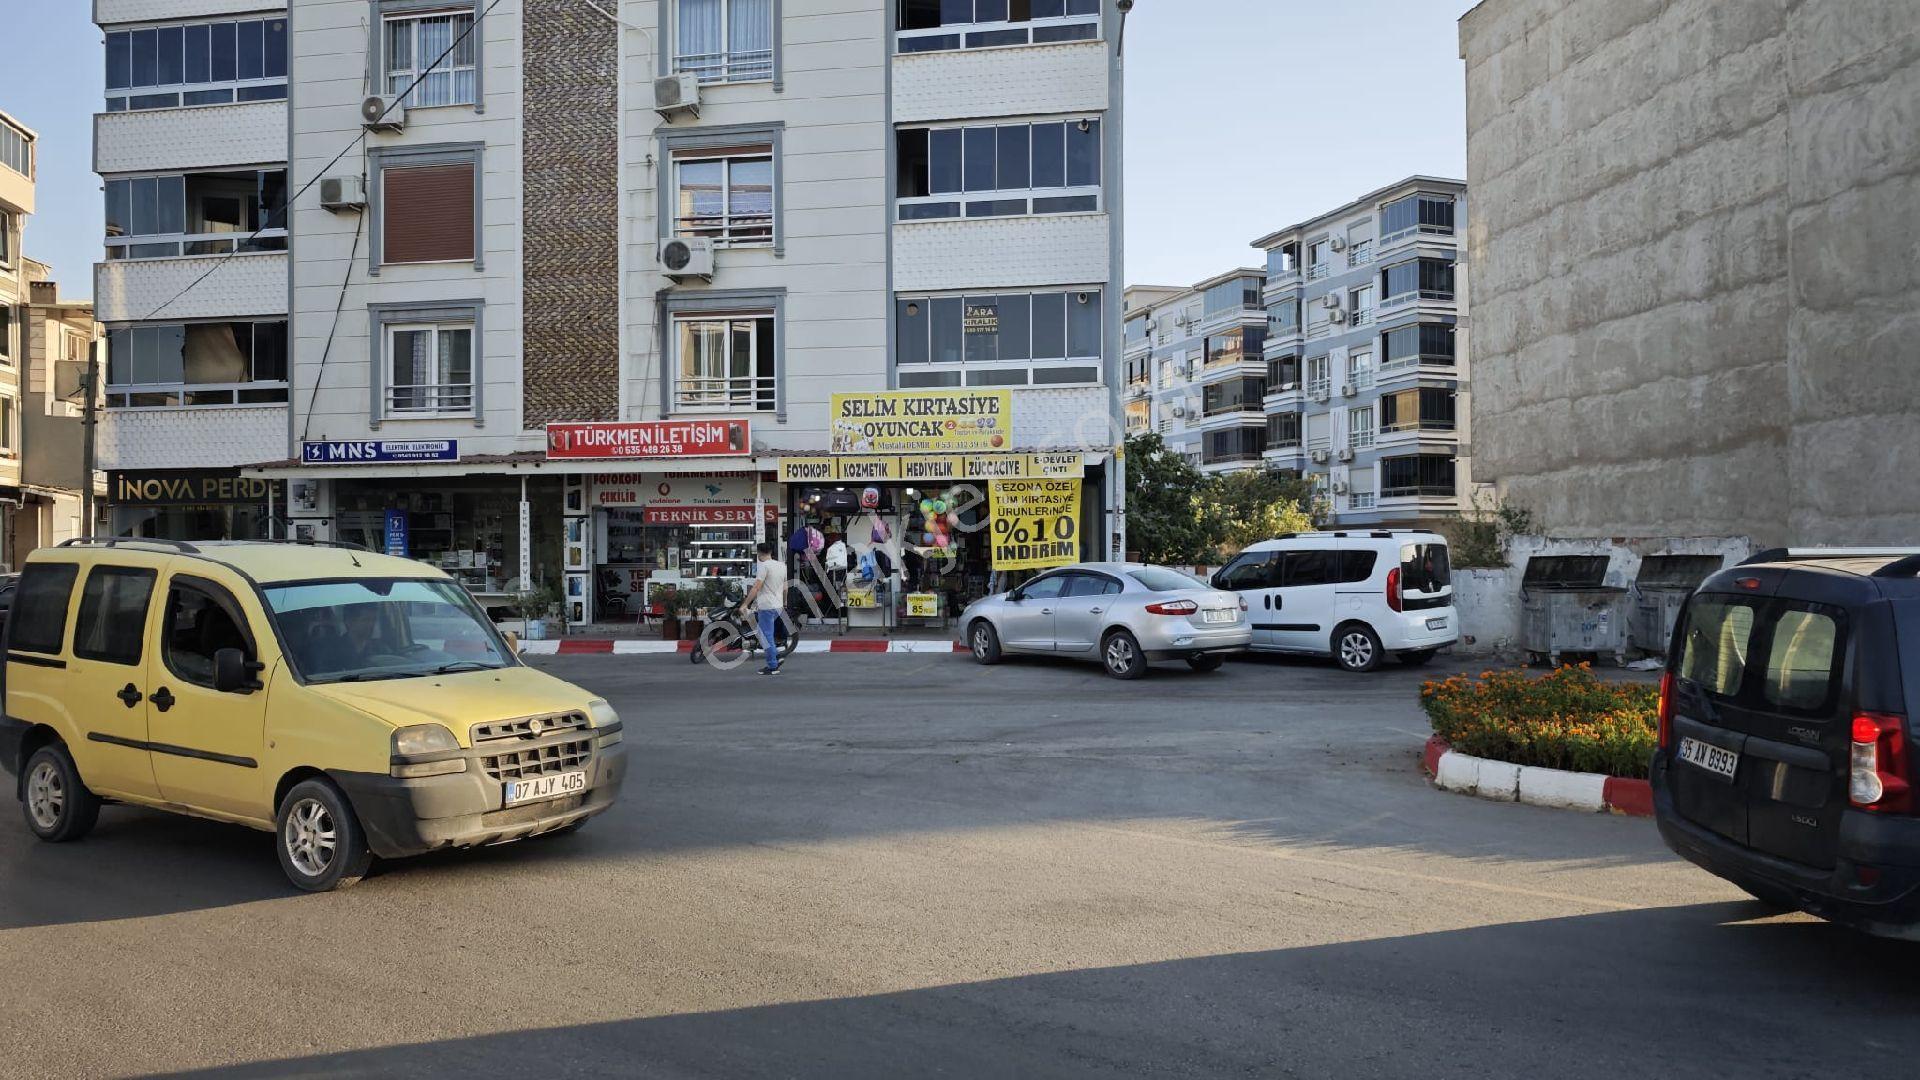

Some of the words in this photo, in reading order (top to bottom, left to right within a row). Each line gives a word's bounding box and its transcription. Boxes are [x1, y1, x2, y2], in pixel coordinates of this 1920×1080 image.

[841, 394, 897, 417] SELİM
[902, 393, 999, 416] KIRTASİYE
[574, 426, 651, 446] TÜRKMEN
[655, 423, 723, 447] İLETİŞİM
[863, 420, 944, 437] OYUNCAK
[329, 441, 377, 460] MNS
[786, 458, 831, 478] FOTOKOPİ
[843, 458, 888, 477] KOZMETİK
[906, 457, 953, 477] HEDİYELİK
[968, 456, 1020, 476] ZÜCCACİYE
[118, 474, 195, 500] İNOVA
[994, 482, 1043, 492] SEZONA
[1046, 480, 1075, 491] ÖZEL
[650, 508, 709, 522] TEKNİK
[713, 509, 776, 521] SERVS
[994, 515, 1075, 544] %10
[849, 598, 861, 607] 20
[515, 783, 529, 799] 07
[533, 779, 556, 796] AJY
[561, 773, 584, 790] 405
